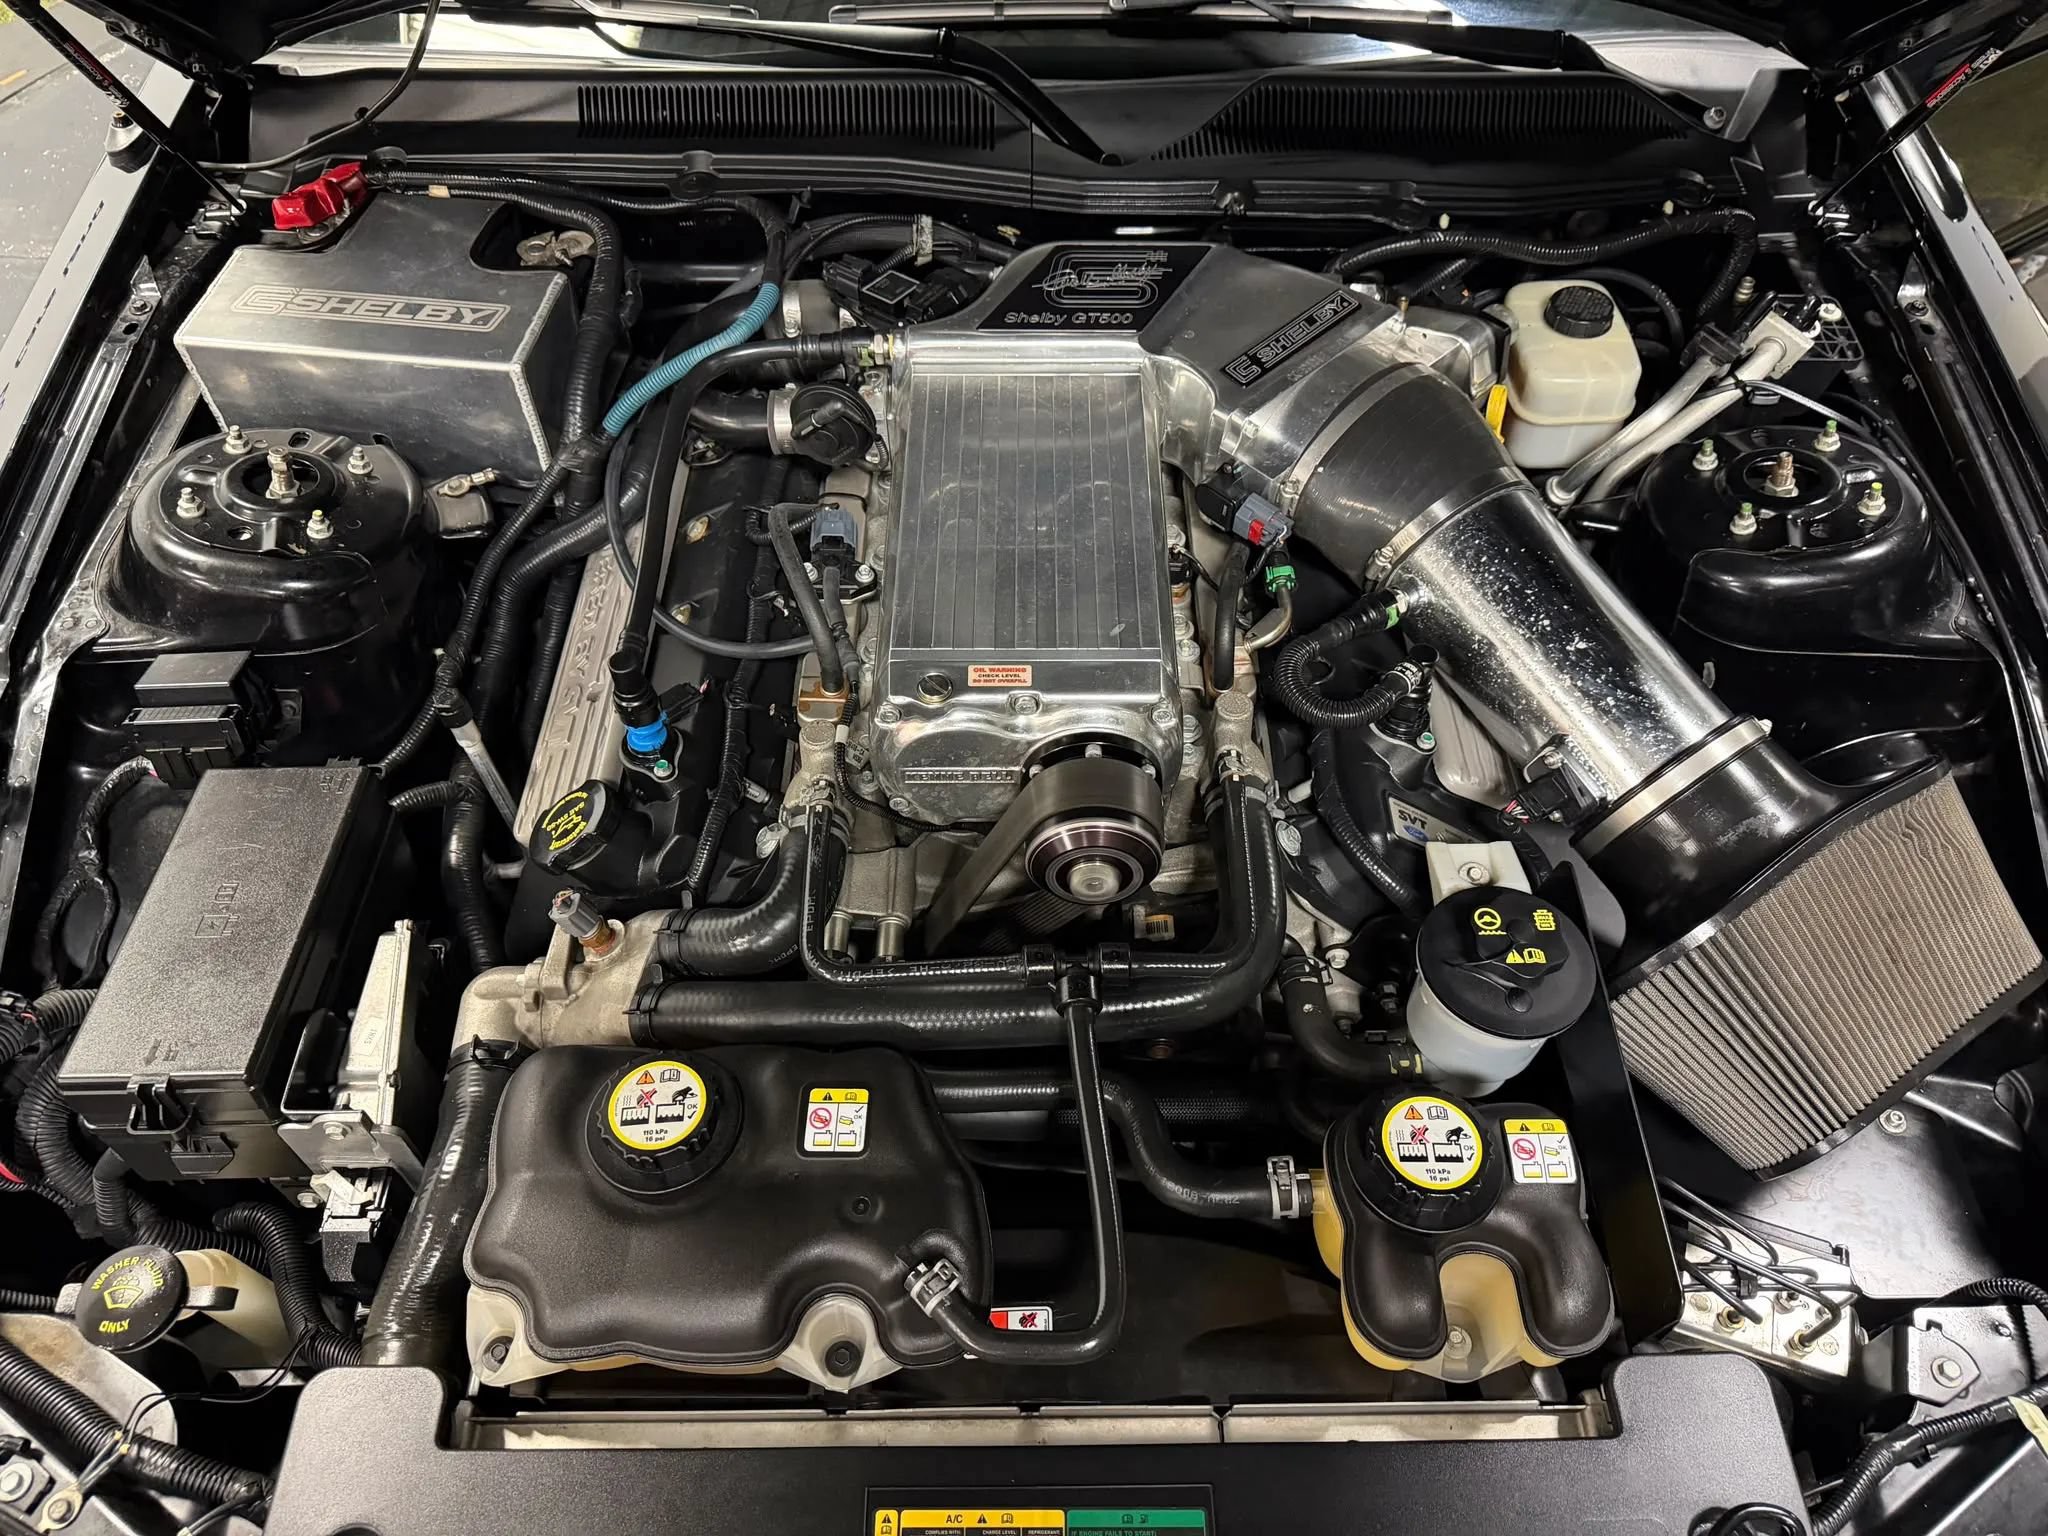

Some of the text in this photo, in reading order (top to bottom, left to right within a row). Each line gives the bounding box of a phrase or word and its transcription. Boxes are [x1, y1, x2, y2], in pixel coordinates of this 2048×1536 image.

[1004, 312, 1133, 326] Shelby GT500
[969, 771, 1011, 780] BELL
[1398, 809, 1427, 830] SVT
[91, 1257, 164, 1291] WASHER FLUID
[98, 1319, 130, 1334] ONLY
[945, 1513, 964, 1524] A/C
